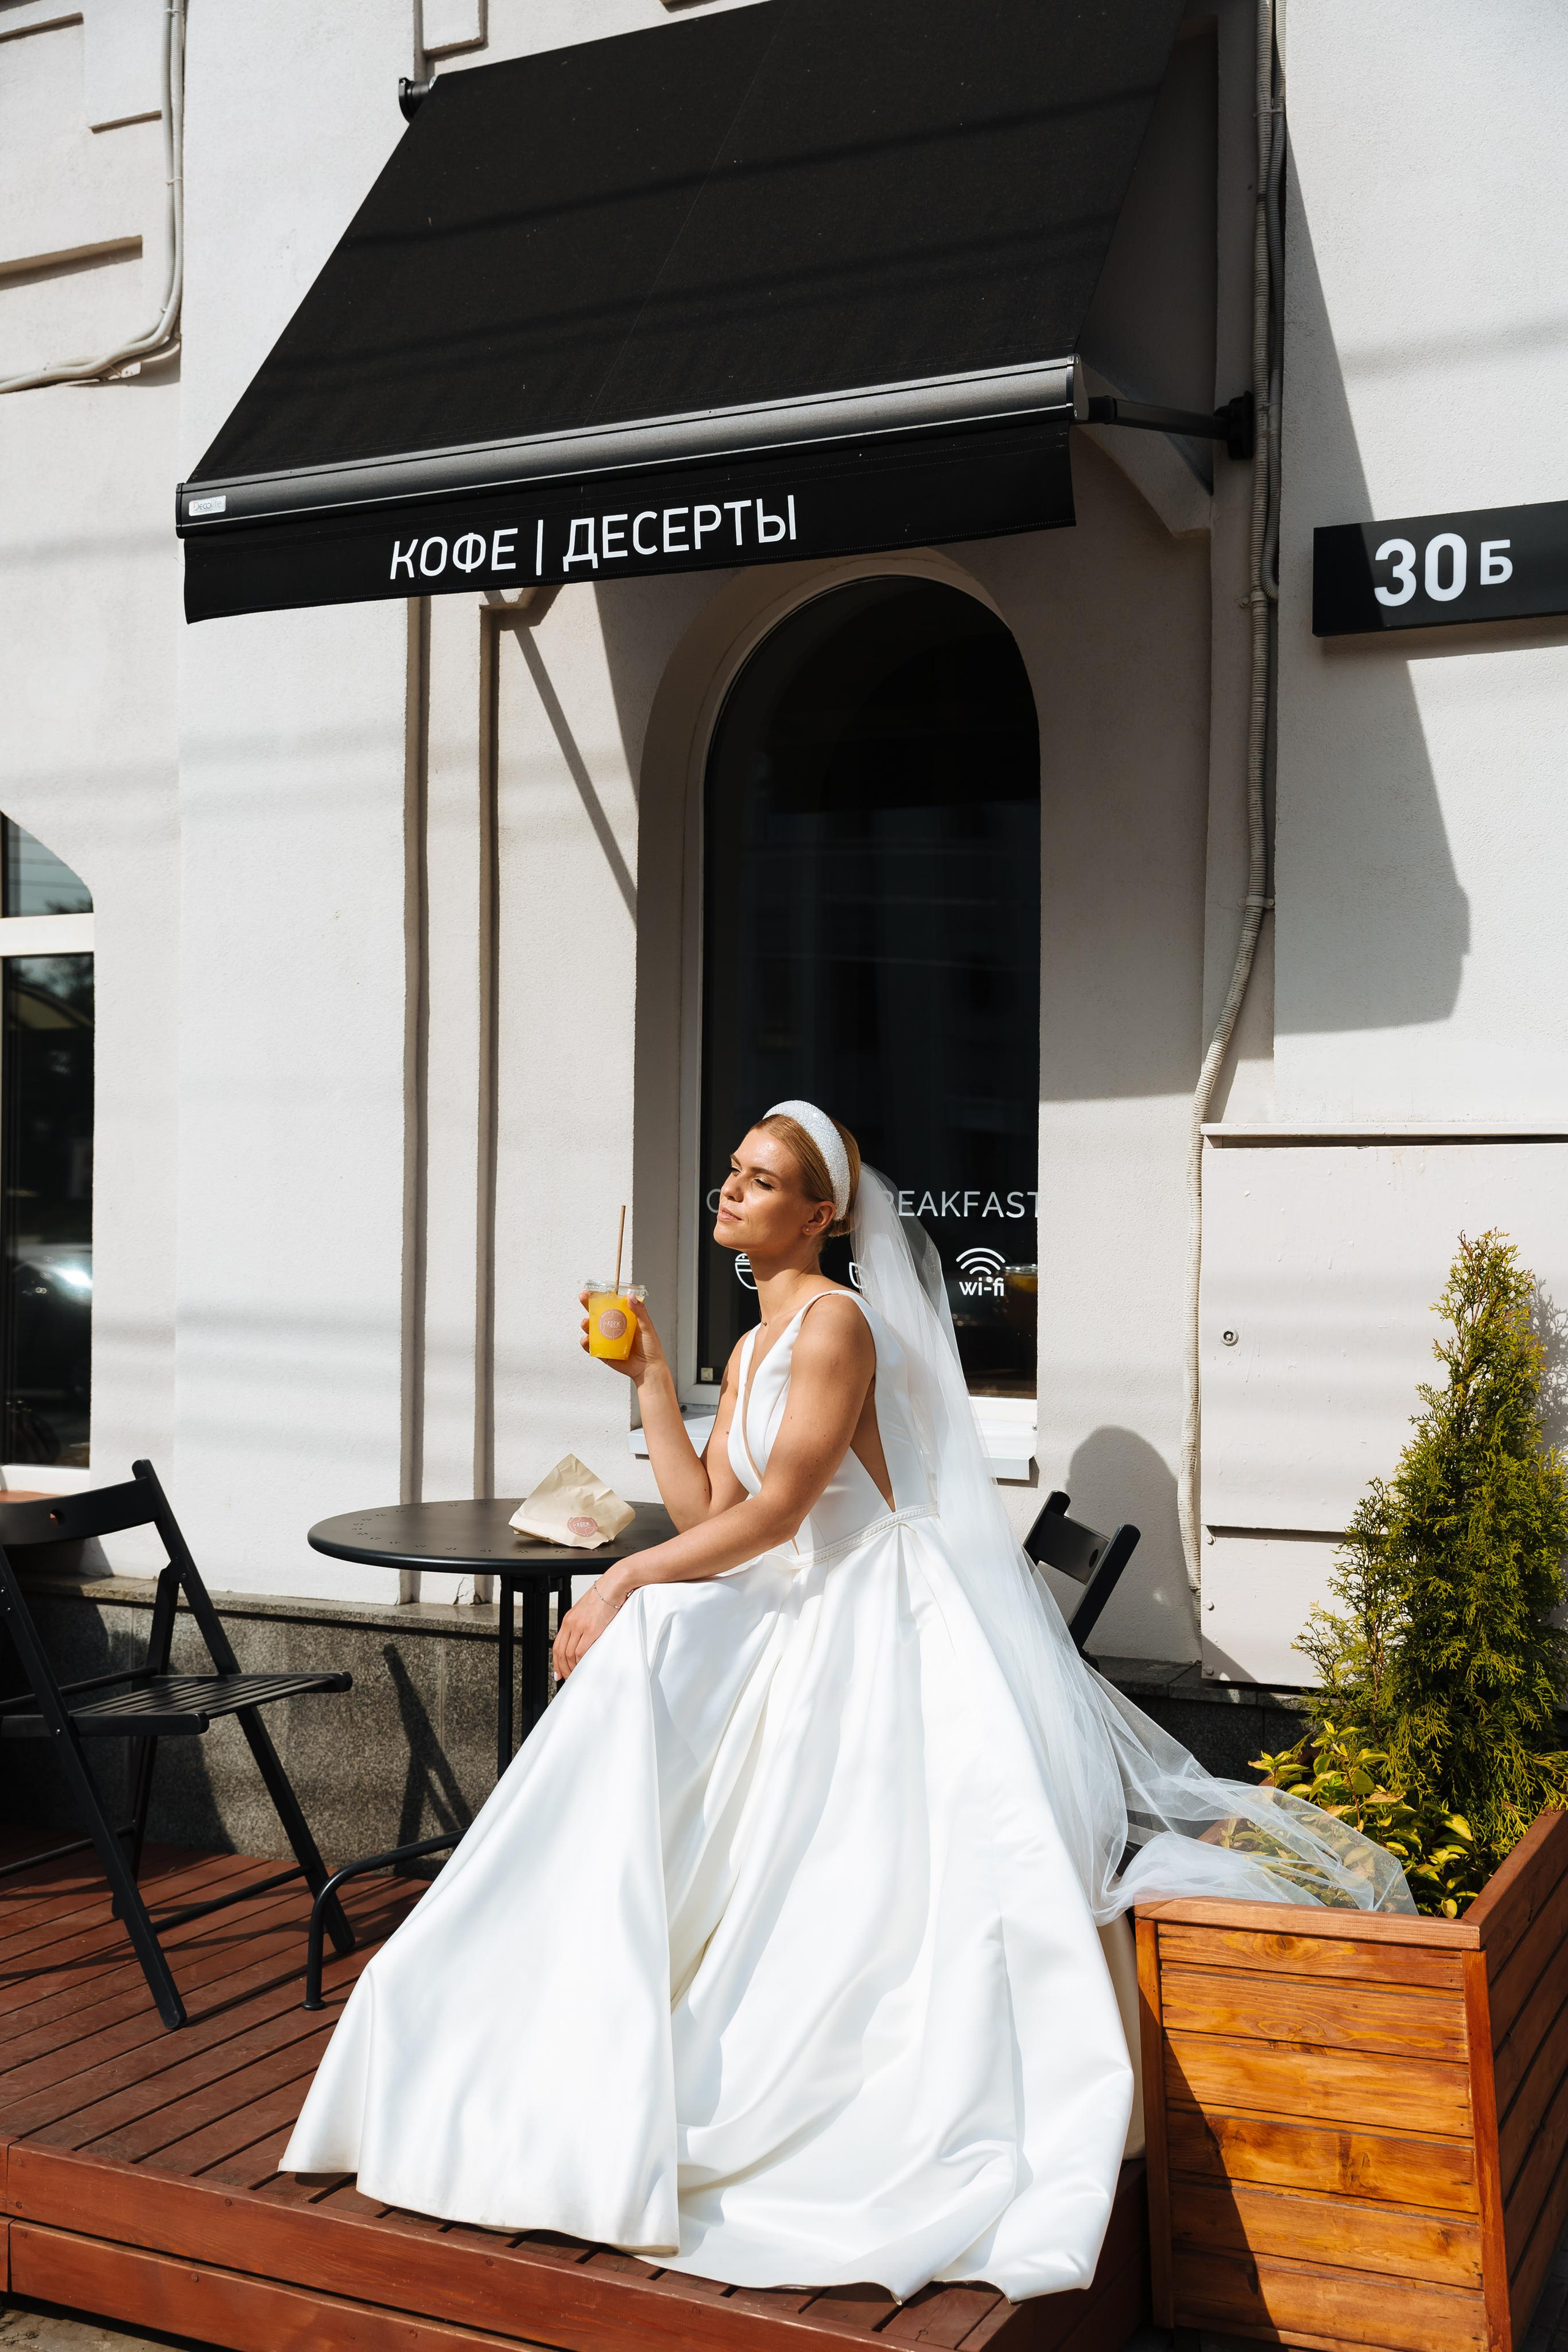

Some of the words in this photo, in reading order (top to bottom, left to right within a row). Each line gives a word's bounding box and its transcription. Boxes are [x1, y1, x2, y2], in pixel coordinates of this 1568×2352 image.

[390, 527, 518, 580] КОФЕ
[562, 494, 796, 572] ДЕСЕРТЫ
[959, 1276, 1005, 1297] wi-fi
